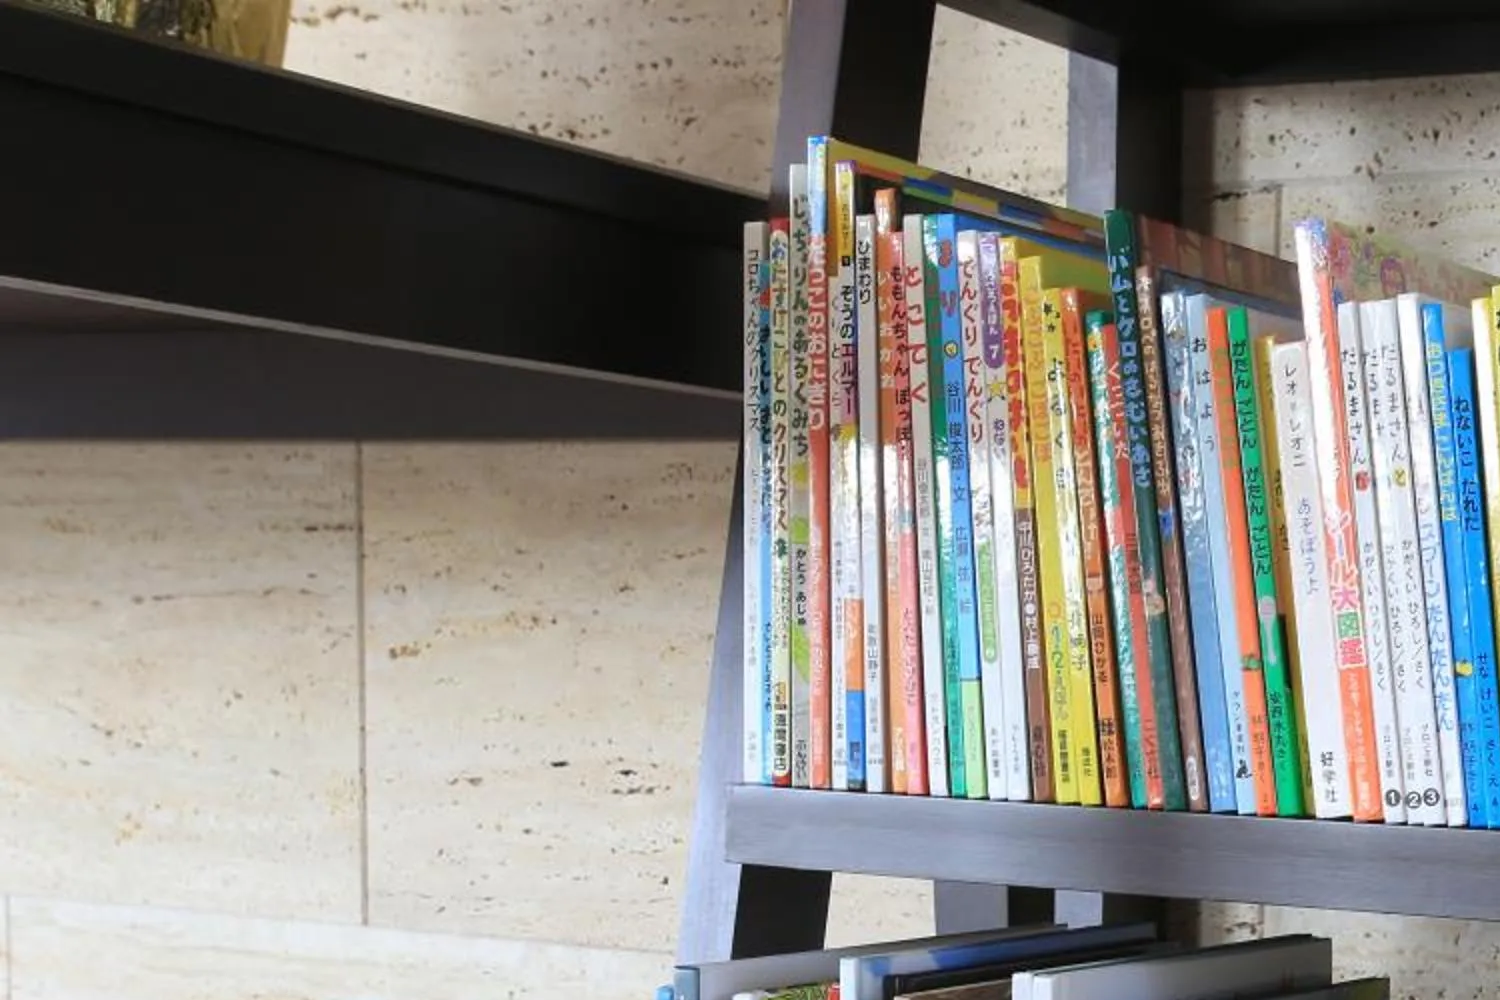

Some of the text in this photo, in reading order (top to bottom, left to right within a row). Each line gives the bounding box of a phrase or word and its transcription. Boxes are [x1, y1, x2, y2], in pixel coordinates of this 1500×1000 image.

[857, 240, 873, 305] ひまわり
[841, 285, 857, 415] ぞうのエルマー
[1453, 398, 1481, 532] ねないこ だれだ
